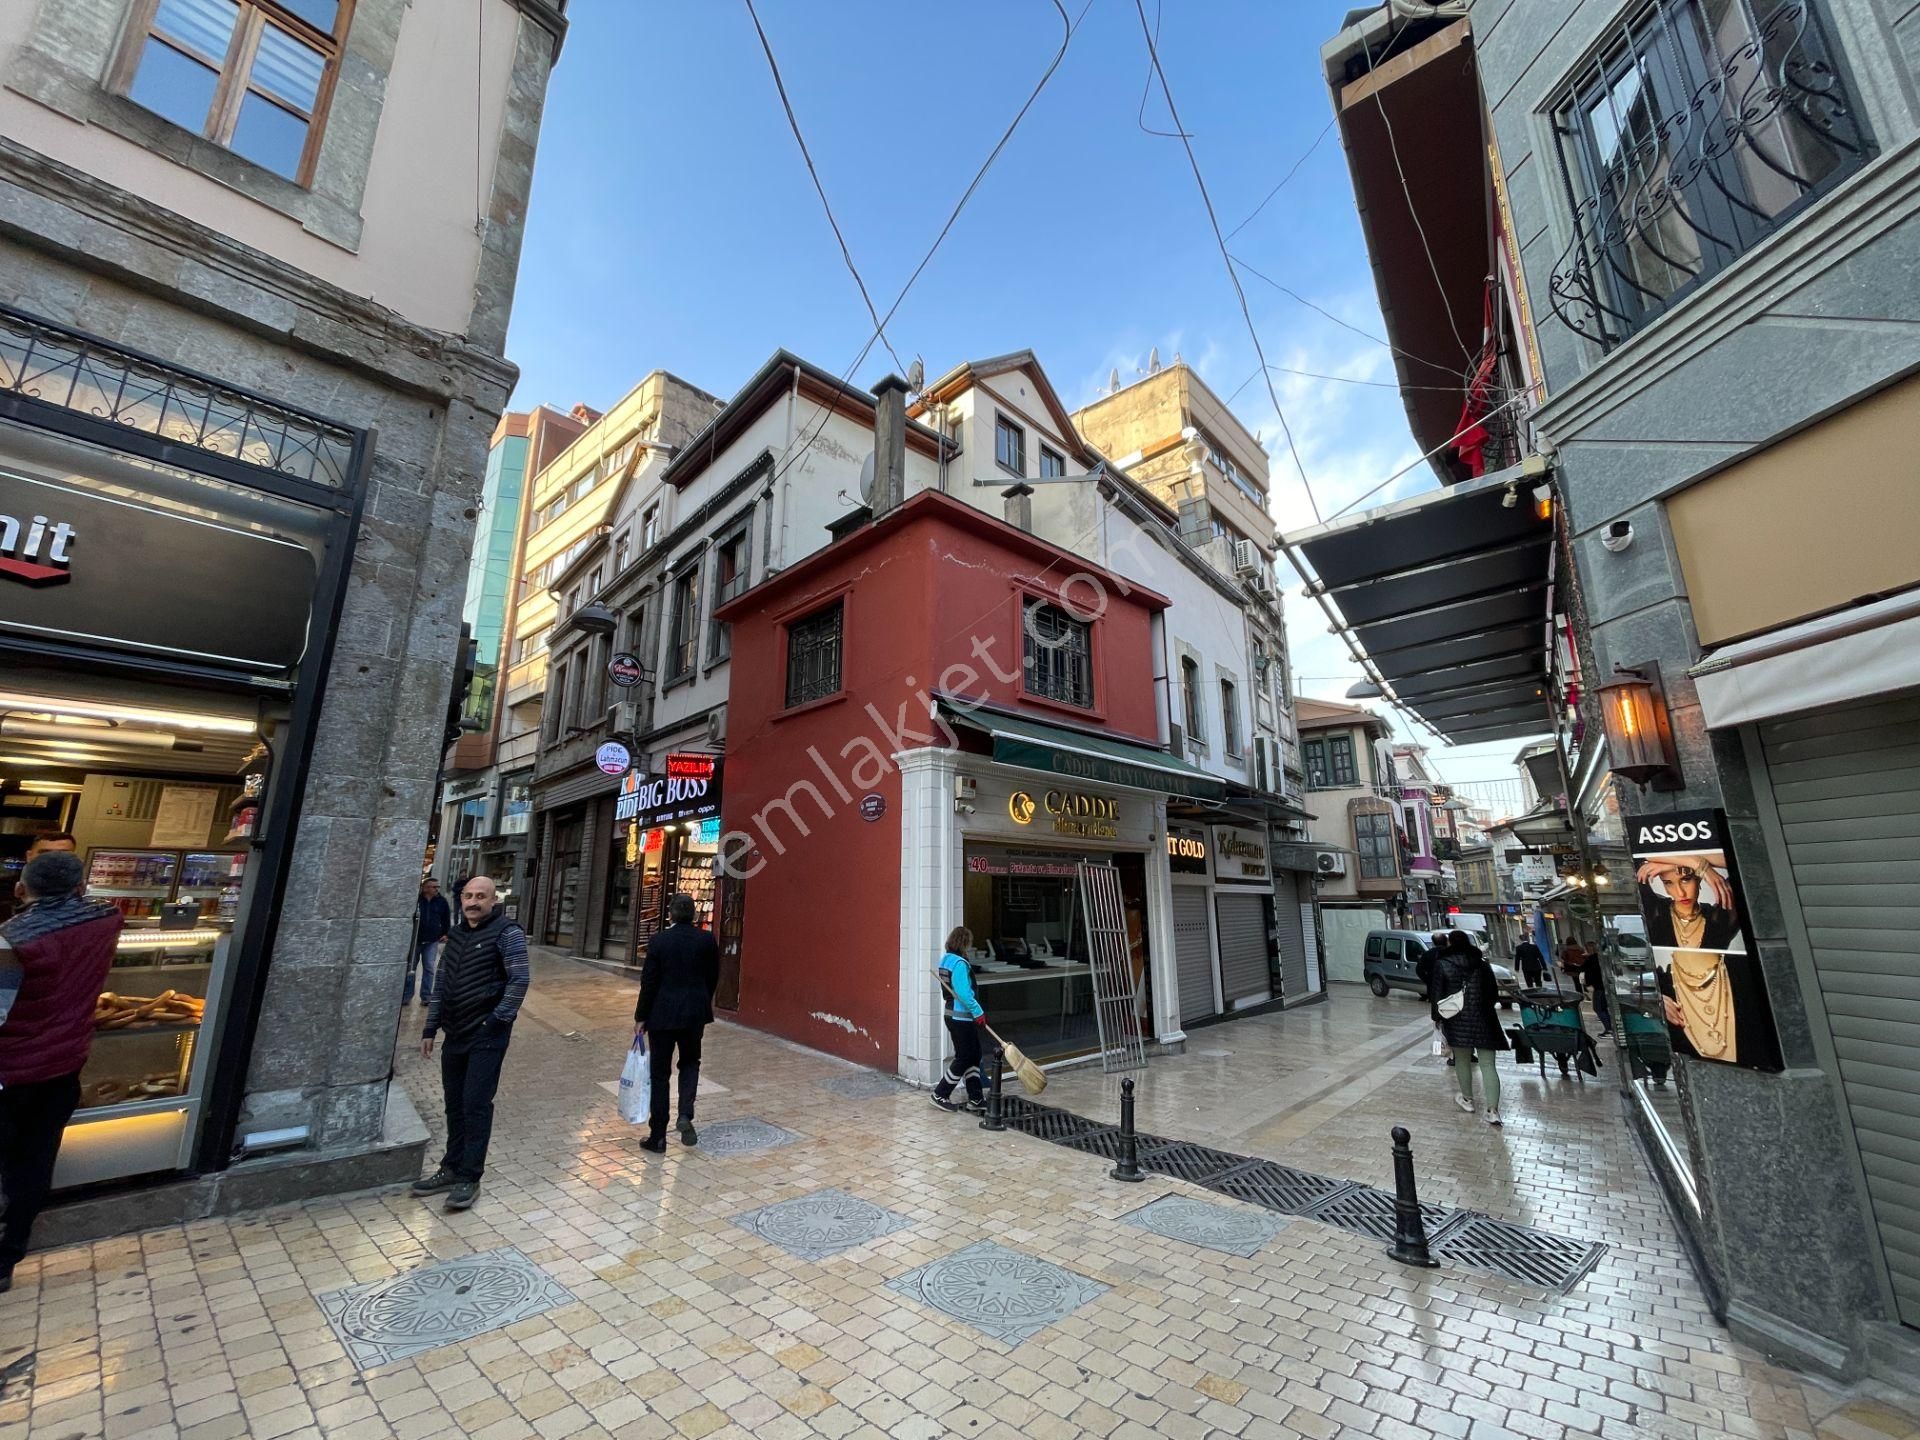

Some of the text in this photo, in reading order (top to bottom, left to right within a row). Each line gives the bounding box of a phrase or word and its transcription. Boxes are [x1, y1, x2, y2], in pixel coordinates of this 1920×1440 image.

[600, 755, 628, 764] Lahmacun
[1052, 754, 1099, 778] CADDE
[638, 779, 708, 811] BIG BOSS
[1045, 790, 1120, 821] CADDE
[698, 804, 716, 814] oppo
[1638, 821, 1712, 844] ASSOS
[1179, 838, 1205, 858] GOLD
